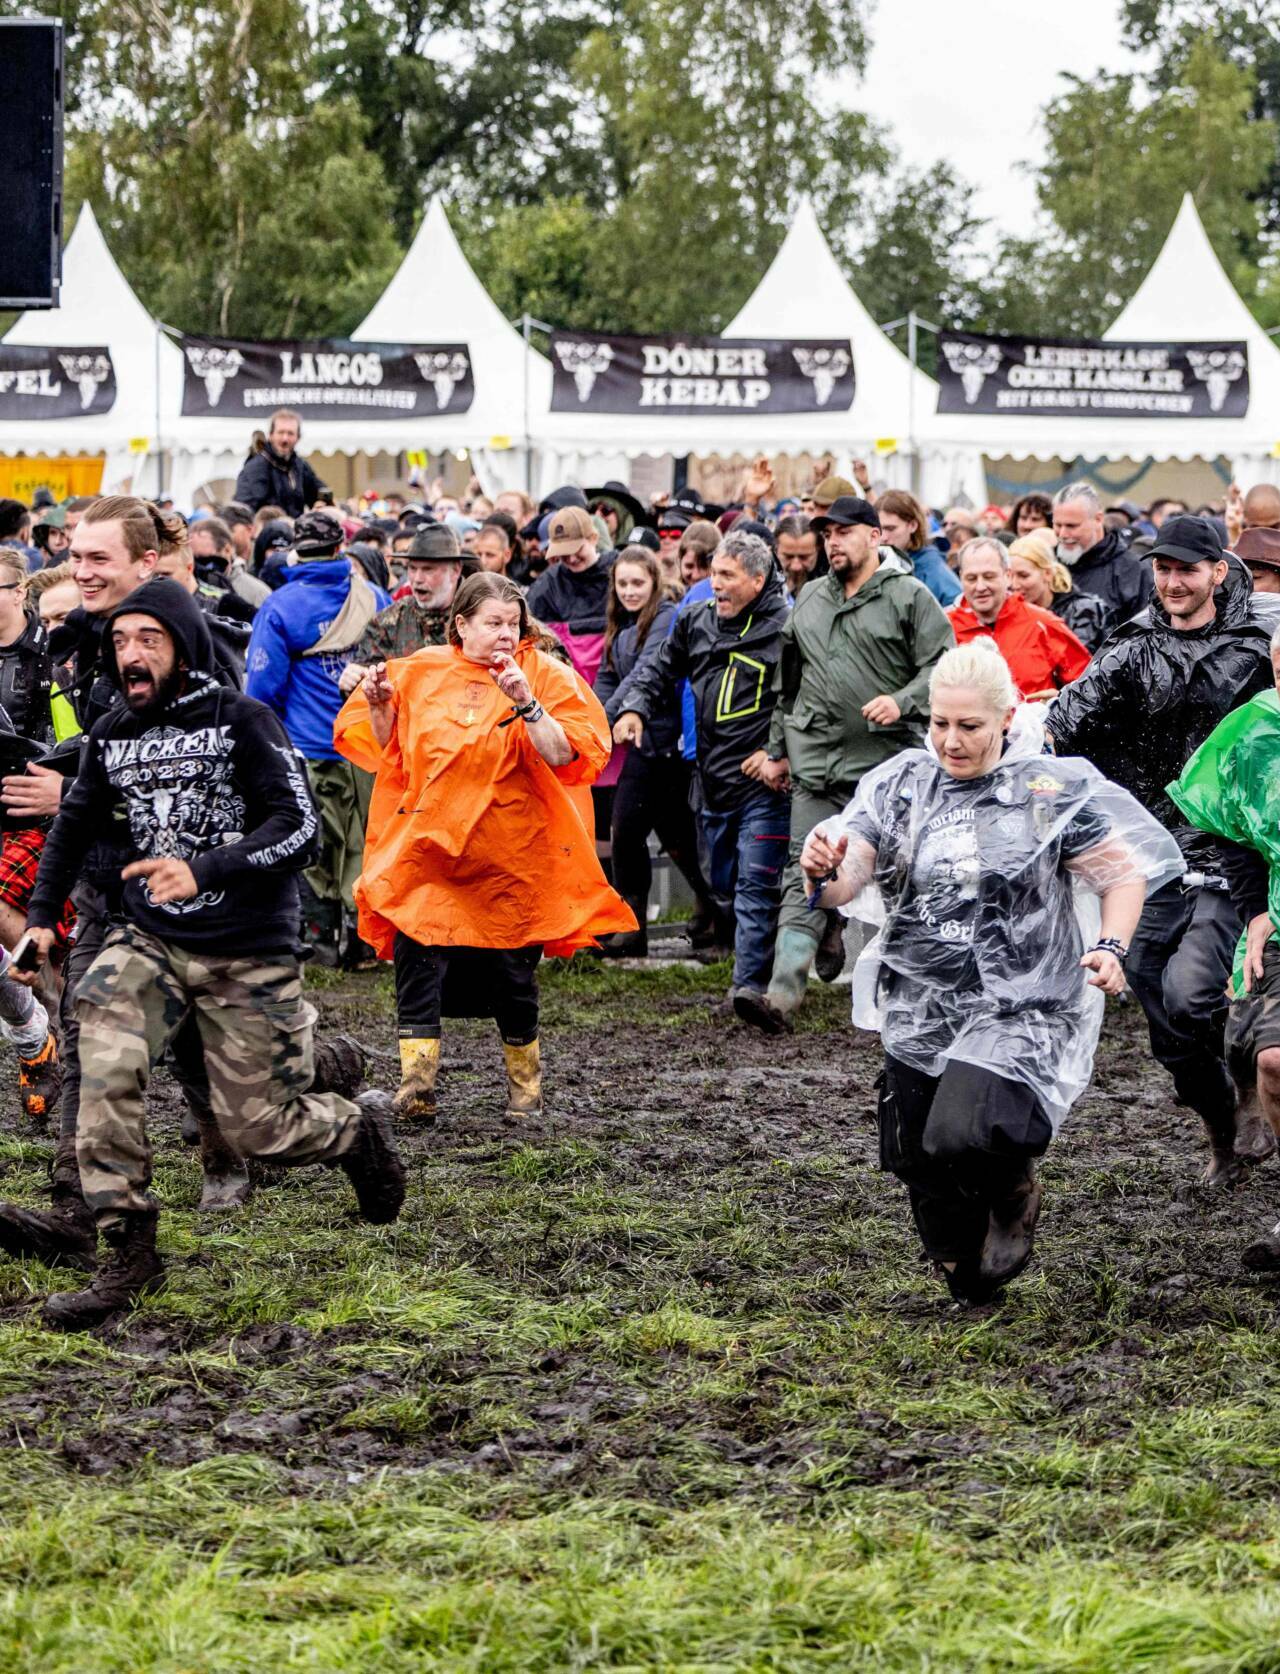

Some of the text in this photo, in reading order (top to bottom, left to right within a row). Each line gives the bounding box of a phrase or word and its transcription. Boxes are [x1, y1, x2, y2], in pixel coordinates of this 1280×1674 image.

[280, 351, 384, 386] LANGOS
[642, 342, 769, 376] DÖNER
[639, 377, 771, 408] KEBAP
[1007, 364, 1185, 393] ODER KASSLER
[97, 725, 232, 773] WACKEN
[120, 760, 198, 787] 2023
